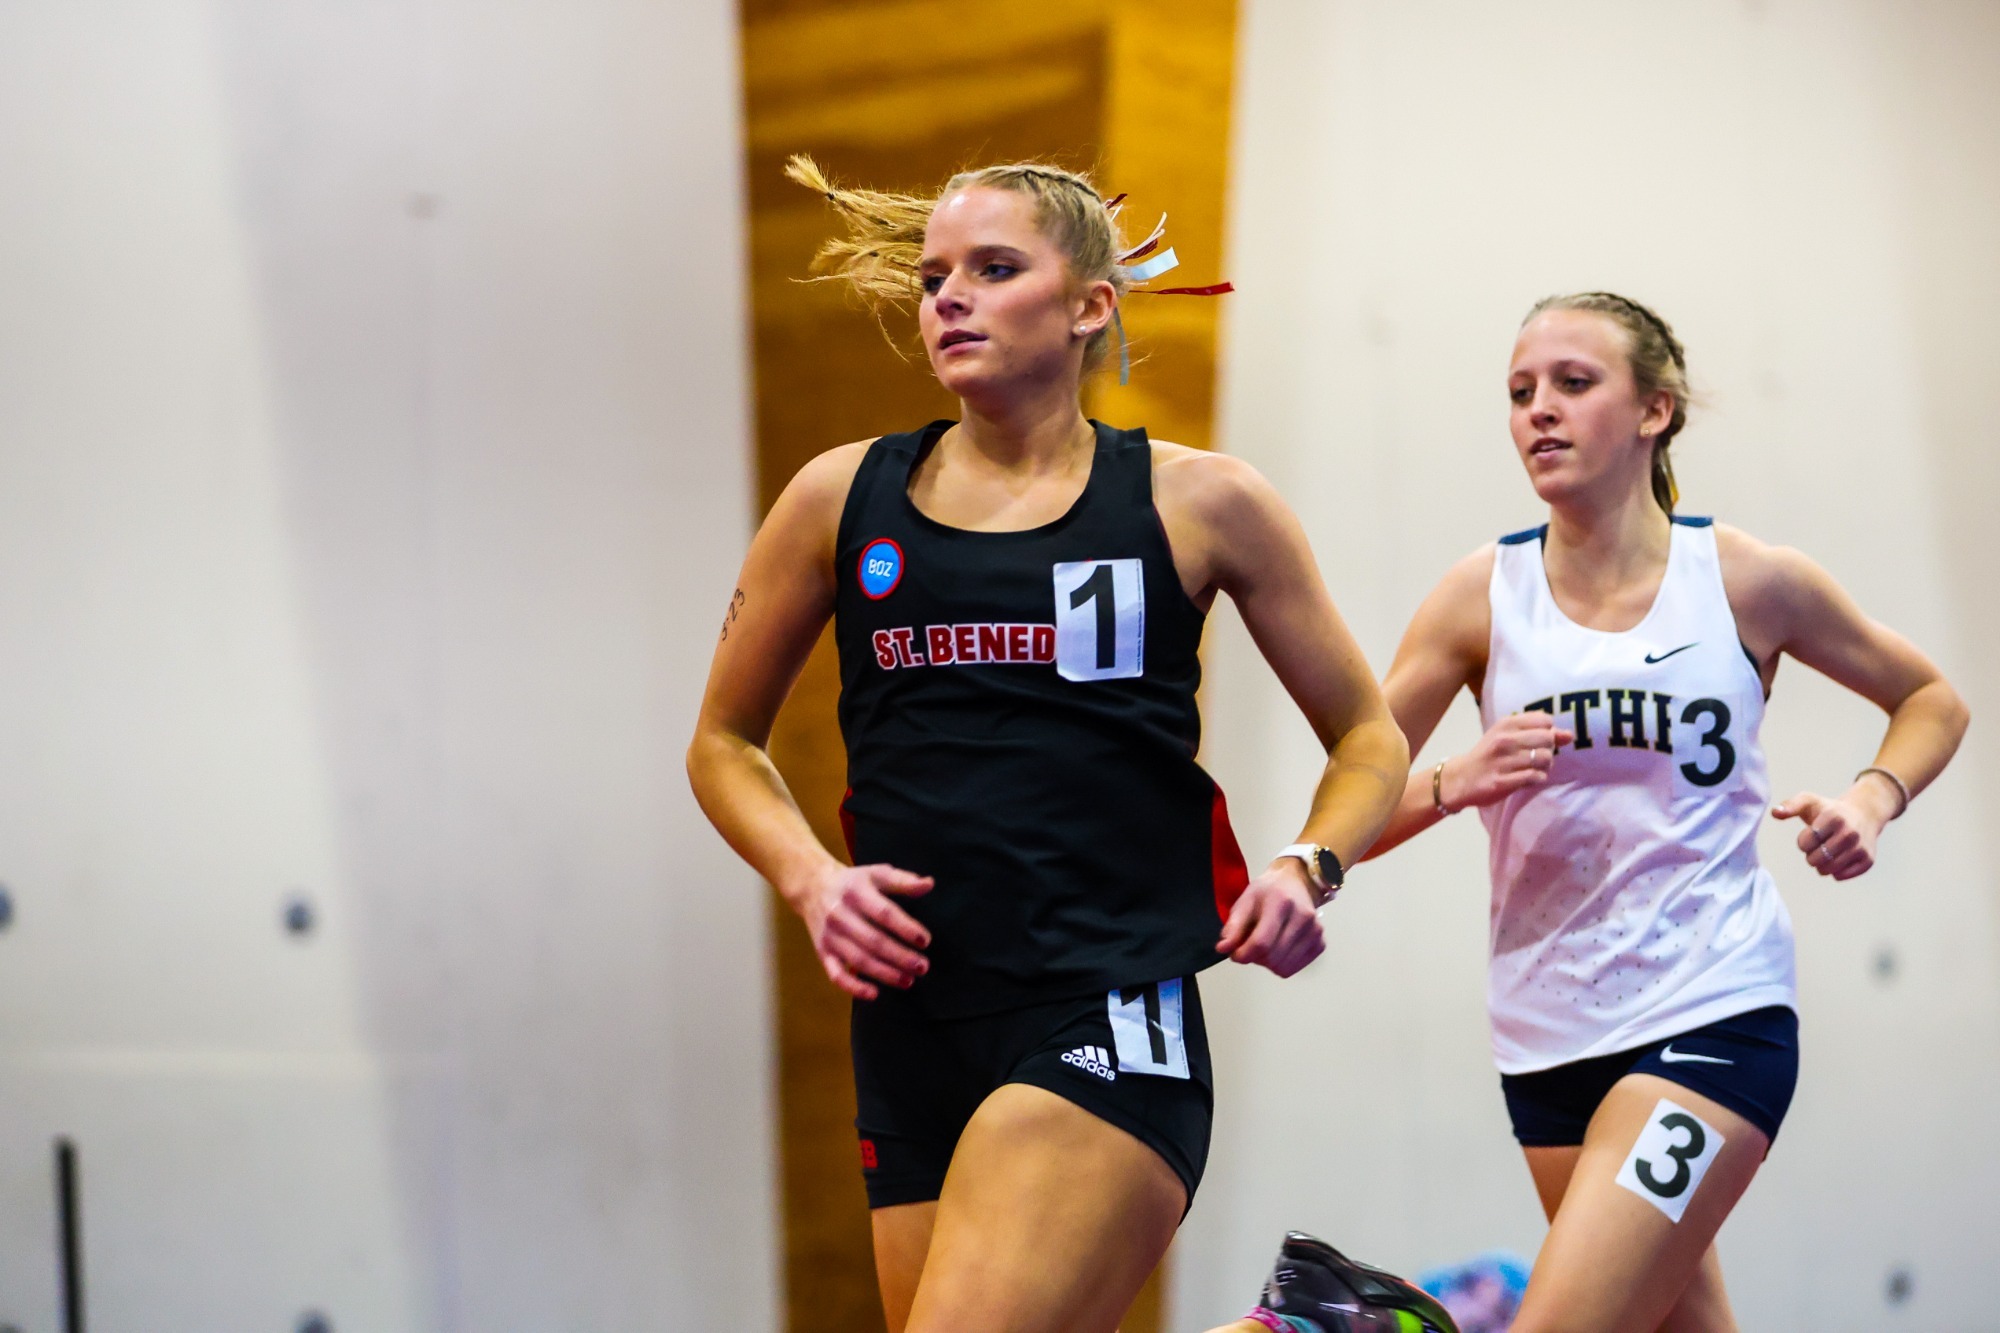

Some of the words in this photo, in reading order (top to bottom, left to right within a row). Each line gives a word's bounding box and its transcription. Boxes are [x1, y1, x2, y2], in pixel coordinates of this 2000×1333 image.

[868, 558, 894, 578] BOZ
[872, 626, 926, 671] ST.
[925, 623, 1058, 667] BENED
[1069, 564, 1116, 670] 1
[1680, 697, 1736, 787] 3
[1119, 980, 1168, 1066] 1
[1060, 1051, 1116, 1082] adidas
[1635, 1112, 1706, 1199] 3
